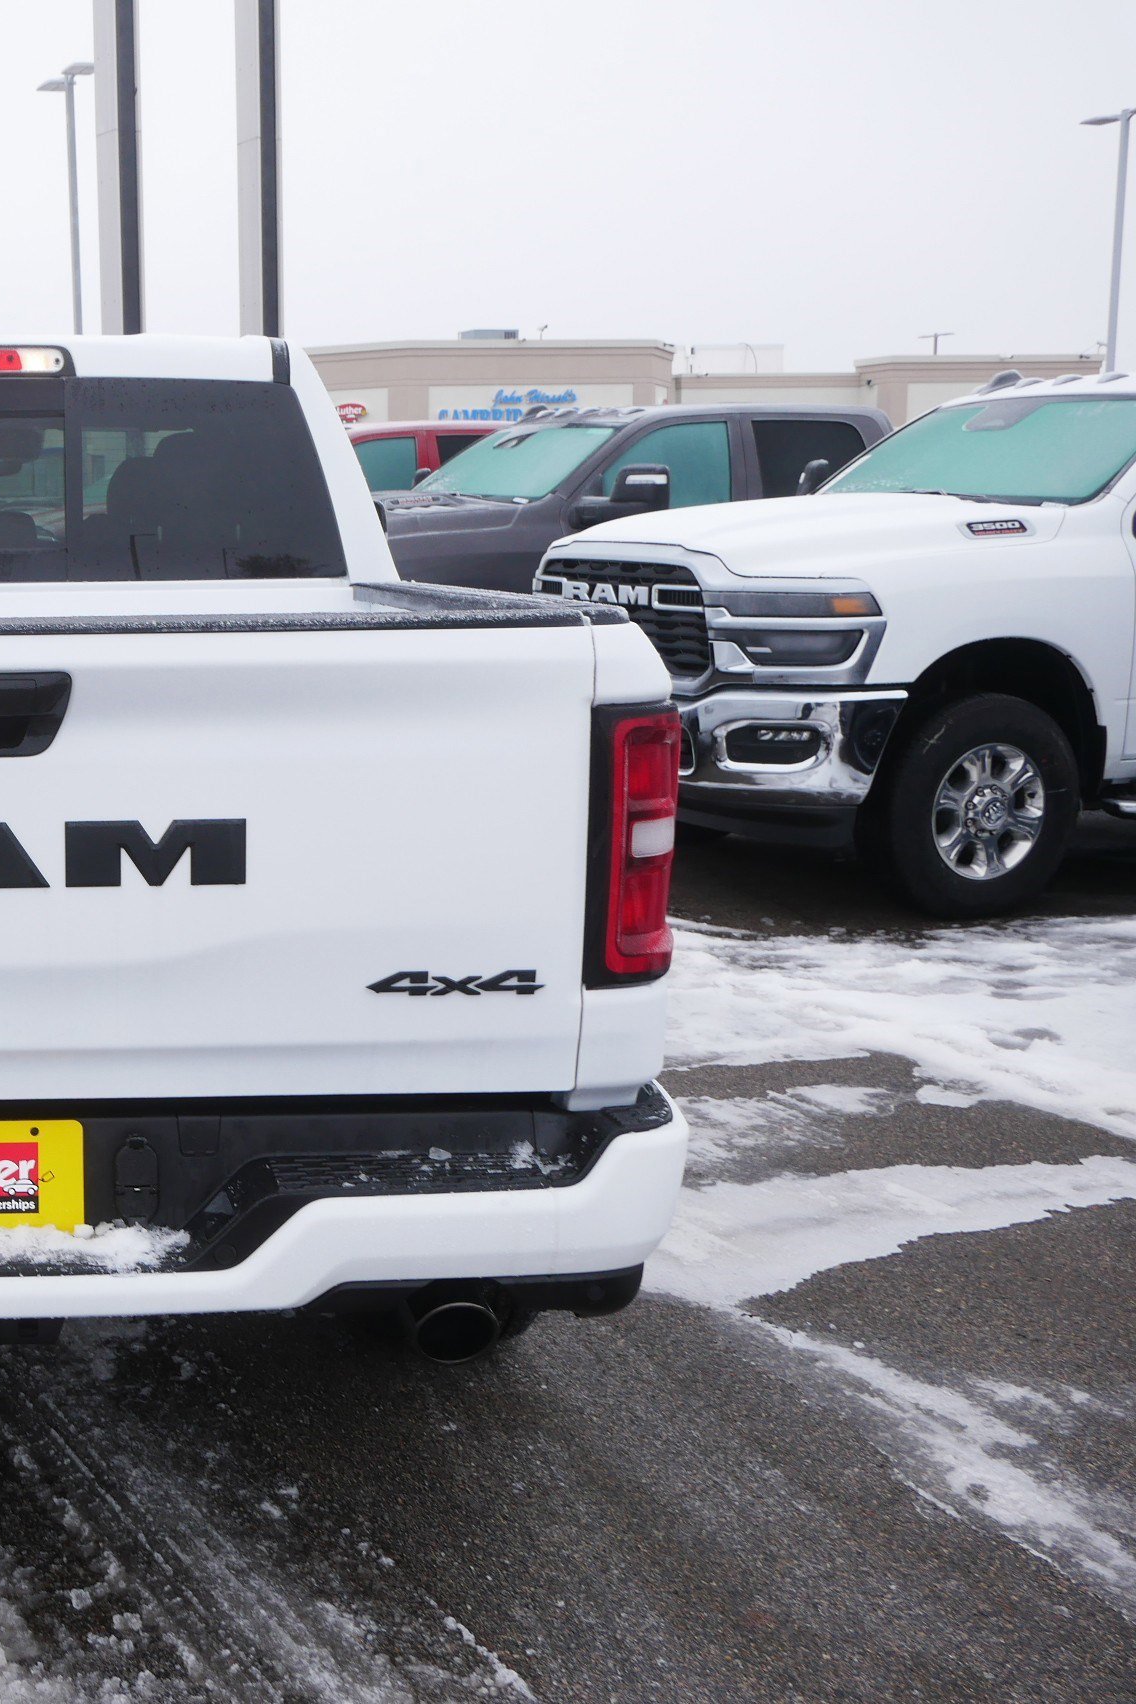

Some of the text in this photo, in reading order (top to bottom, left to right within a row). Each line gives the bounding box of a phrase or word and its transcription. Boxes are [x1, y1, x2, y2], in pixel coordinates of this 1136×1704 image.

[493, 389, 523, 406] John
[971, 522, 1020, 531] 3500
[565, 581, 649, 605] RAM
[366, 969, 545, 996] 4x4
